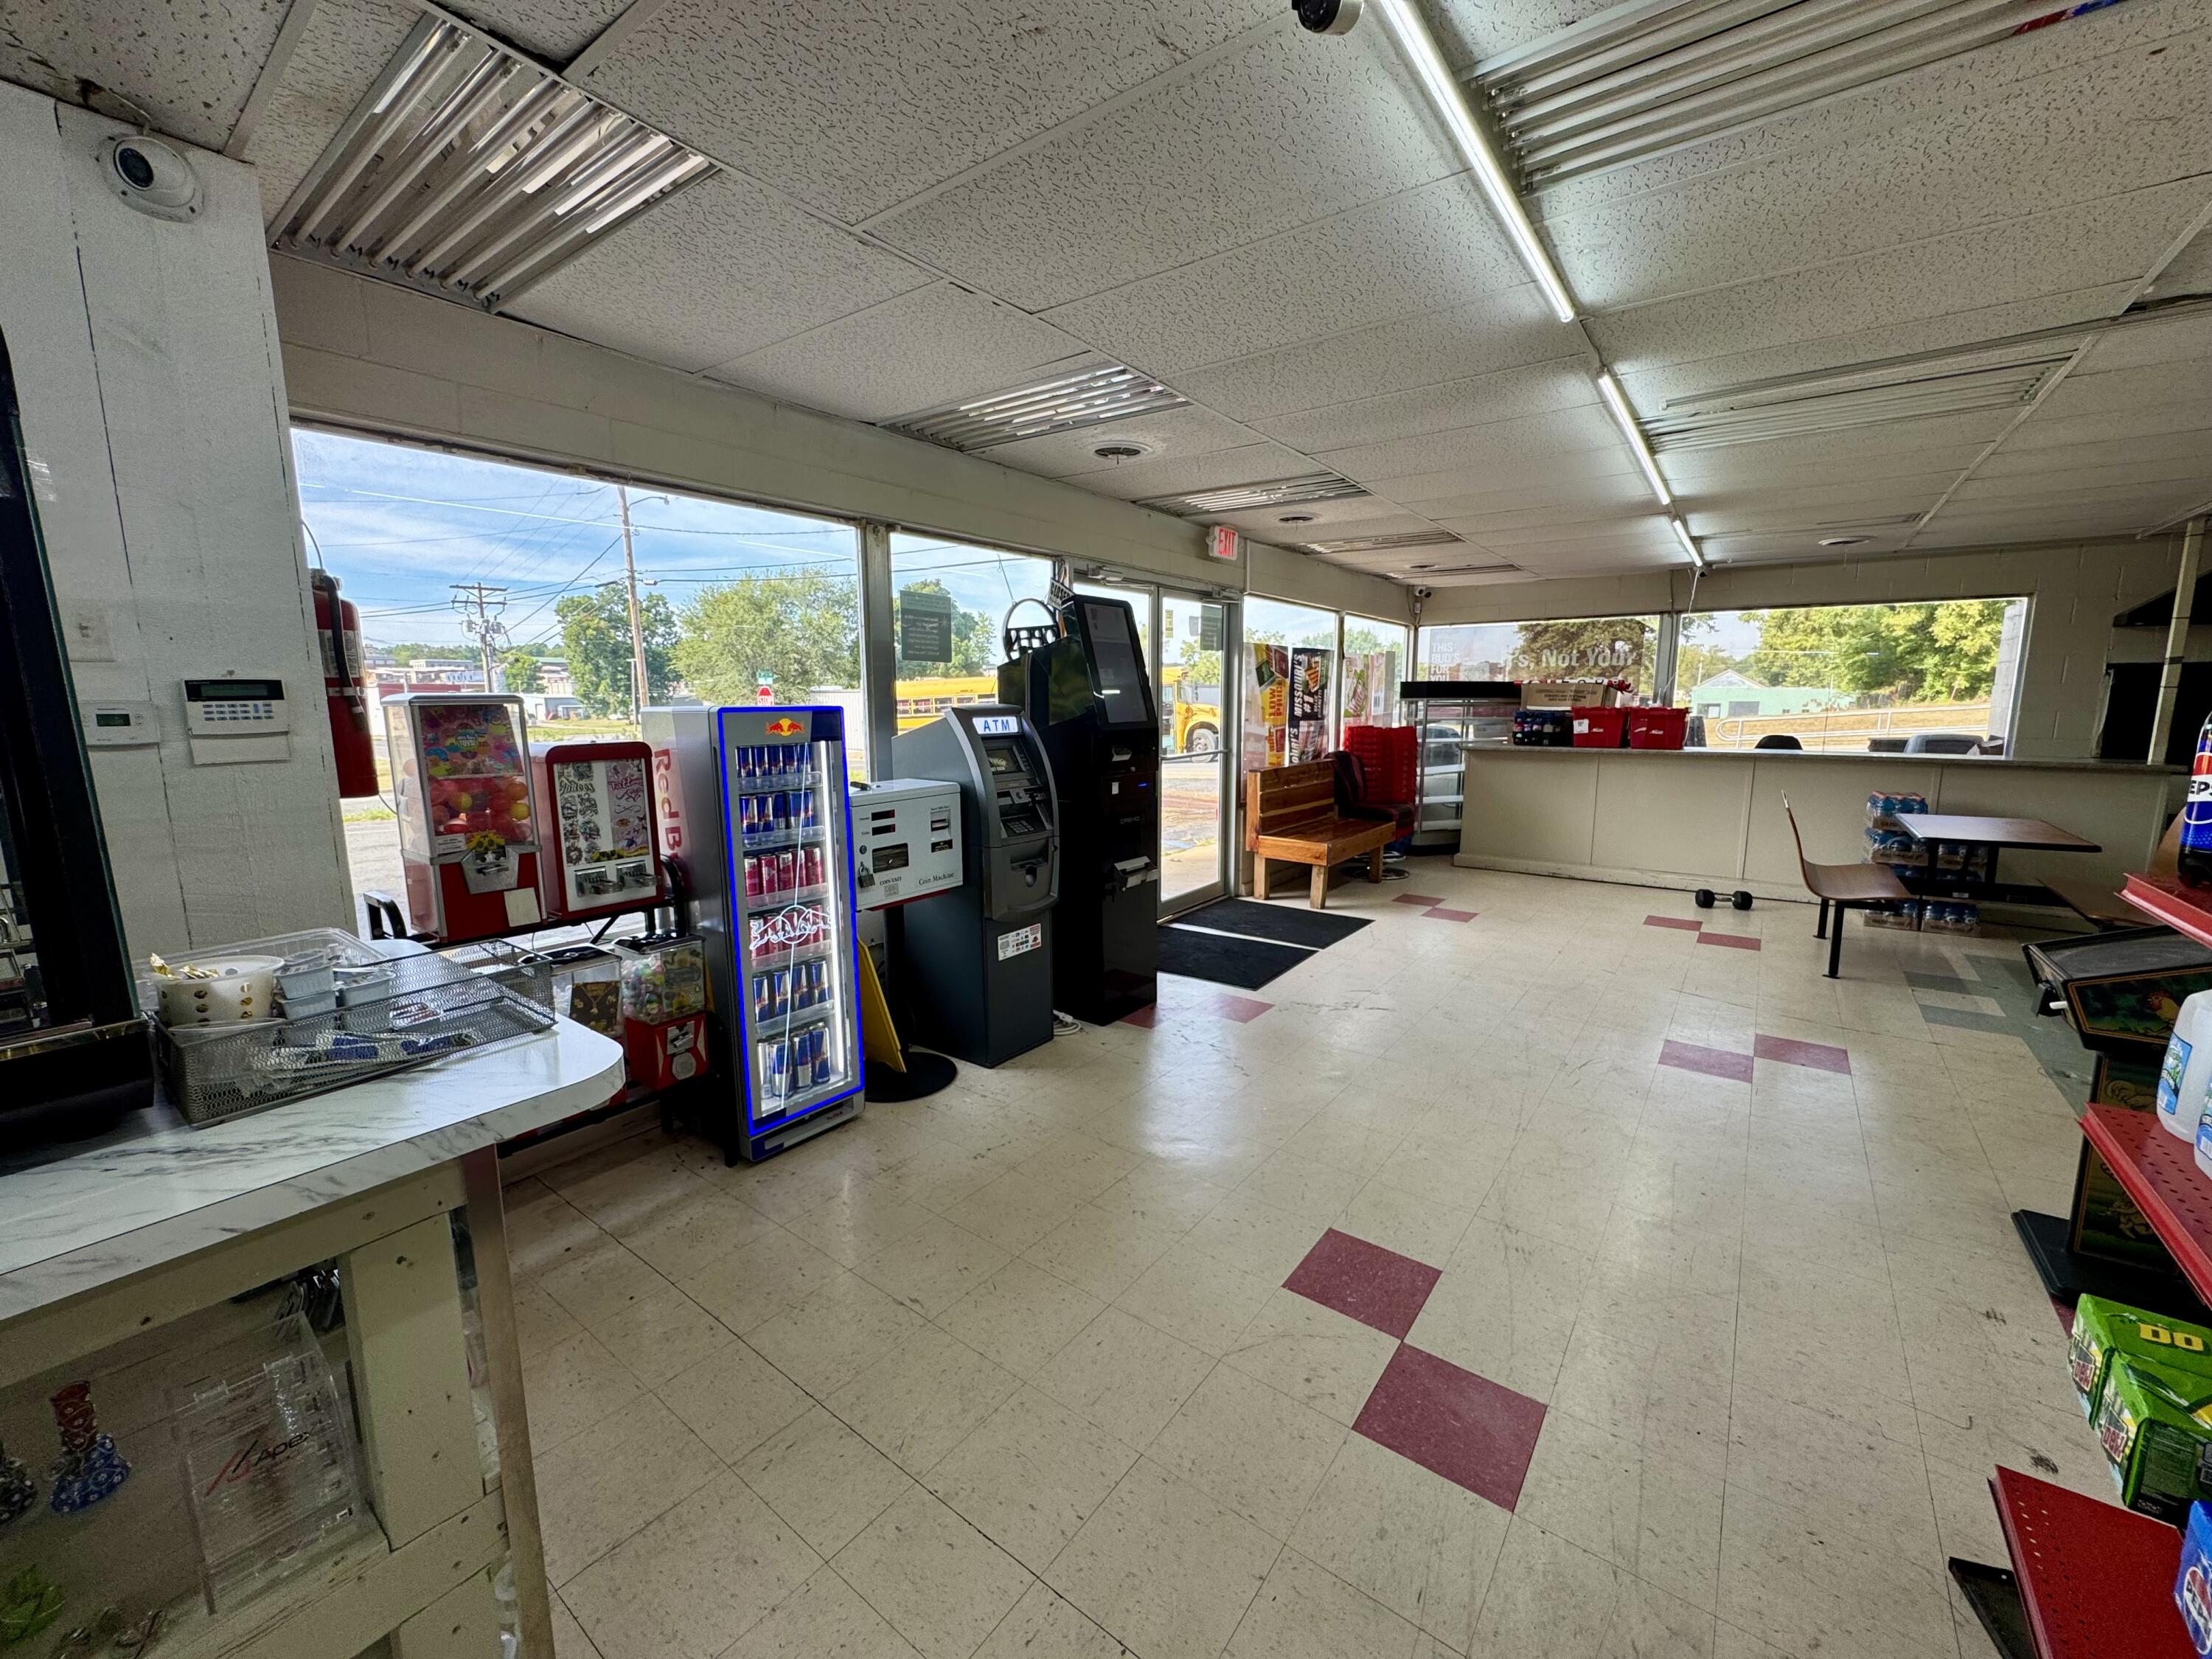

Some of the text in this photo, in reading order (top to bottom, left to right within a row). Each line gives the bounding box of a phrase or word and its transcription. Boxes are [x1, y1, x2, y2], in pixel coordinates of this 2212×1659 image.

[1218, 528, 1236, 557] EXIT
[1432, 642, 1453, 653] THIS
[1431, 653, 1461, 663] BUD'S
[1541, 649, 1580, 667] Not
[1430, 664, 1450, 674] FOR
[1293, 654, 1304, 717] MISSOURI'S
[758, 695, 774, 706] STOP
[1268, 687, 1276, 717] LOW
[1303, 694, 1314, 714] #1
[984, 719, 1010, 732] ATM
[1290, 728, 1299, 764] OURI'S
[653, 748, 679, 820] Red
[919, 872, 954, 886] Coin Machine
